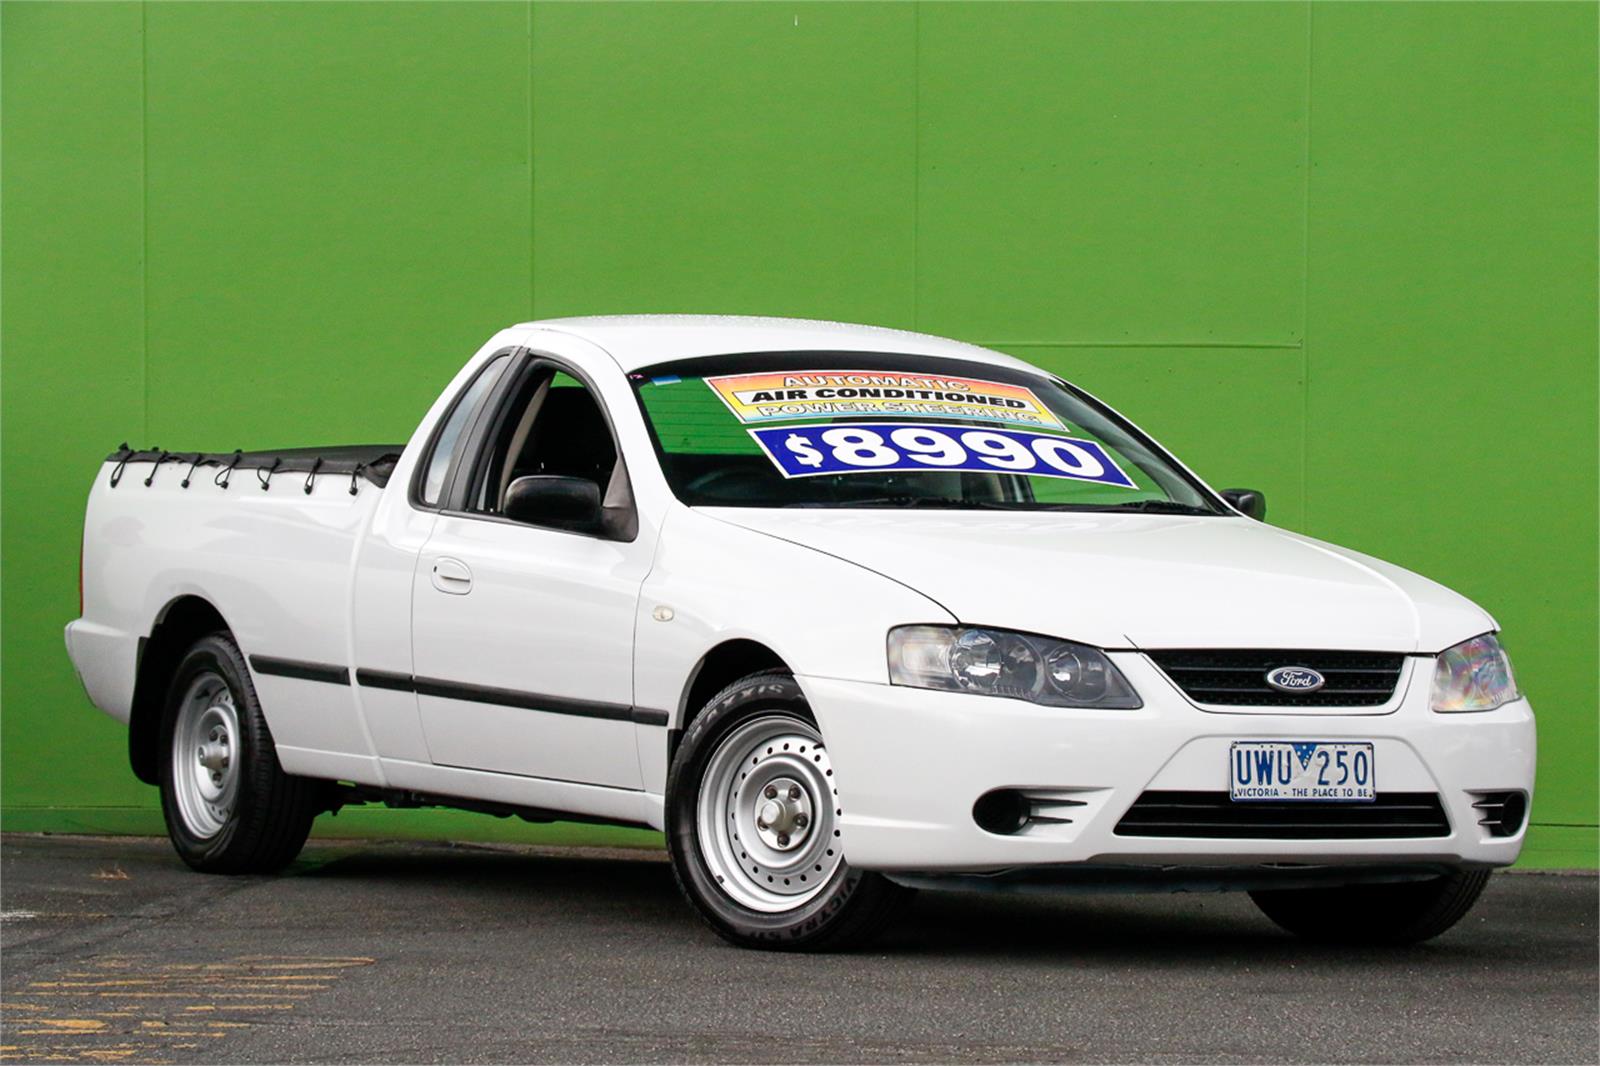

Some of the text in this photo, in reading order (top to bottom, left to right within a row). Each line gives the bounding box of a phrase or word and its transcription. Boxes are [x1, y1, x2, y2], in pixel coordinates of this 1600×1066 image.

[783, 375, 971, 392] AUTOMATIC
[751, 388, 1026, 409] AIR CONDITIONED
[756, 402, 1042, 424] POWER STEERING
[784, 427, 1105, 478] $8990
[1280, 671, 1312, 687] Ford
[1236, 750, 1368, 786] UWU 250
[1237, 788, 1279, 798] VICTORIA
[1292, 788, 1308, 798] THE
[1312, 788, 1338, 798] PLACE
[1342, 788, 1353, 798] TO
[1357, 788, 1368, 798] BE
